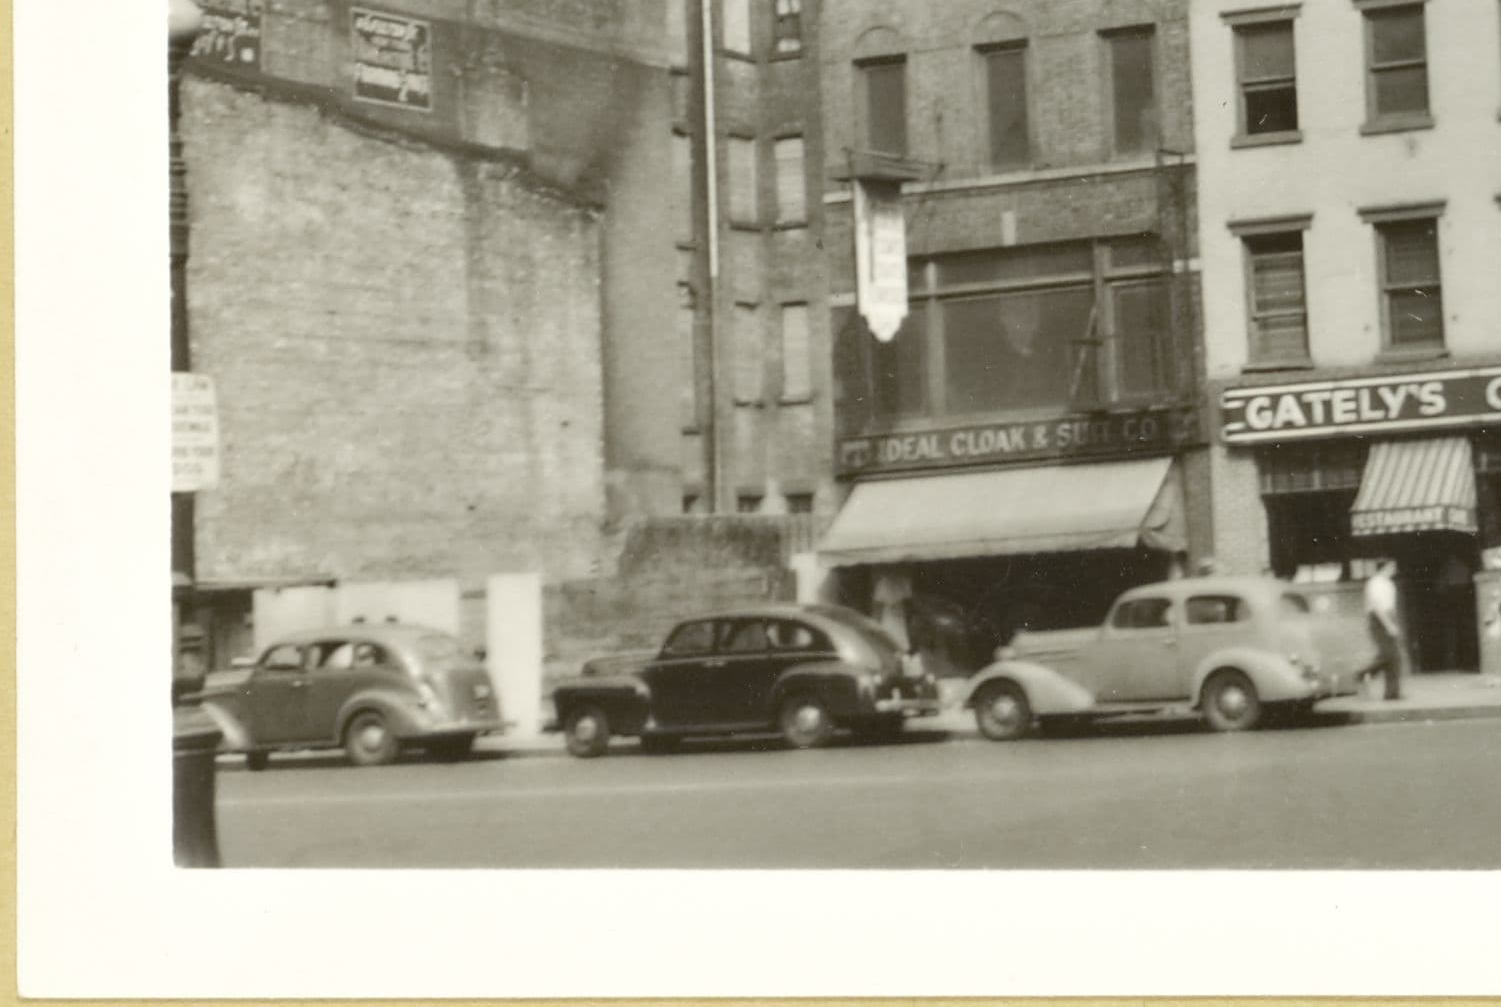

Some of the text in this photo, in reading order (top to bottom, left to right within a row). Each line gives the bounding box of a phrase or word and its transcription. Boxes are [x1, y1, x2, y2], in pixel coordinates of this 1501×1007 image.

[1245, 381, 1447, 430] GATELY'S
[878, 434, 944, 462] IDEAL
[951, 427, 1026, 456] CLOAK
